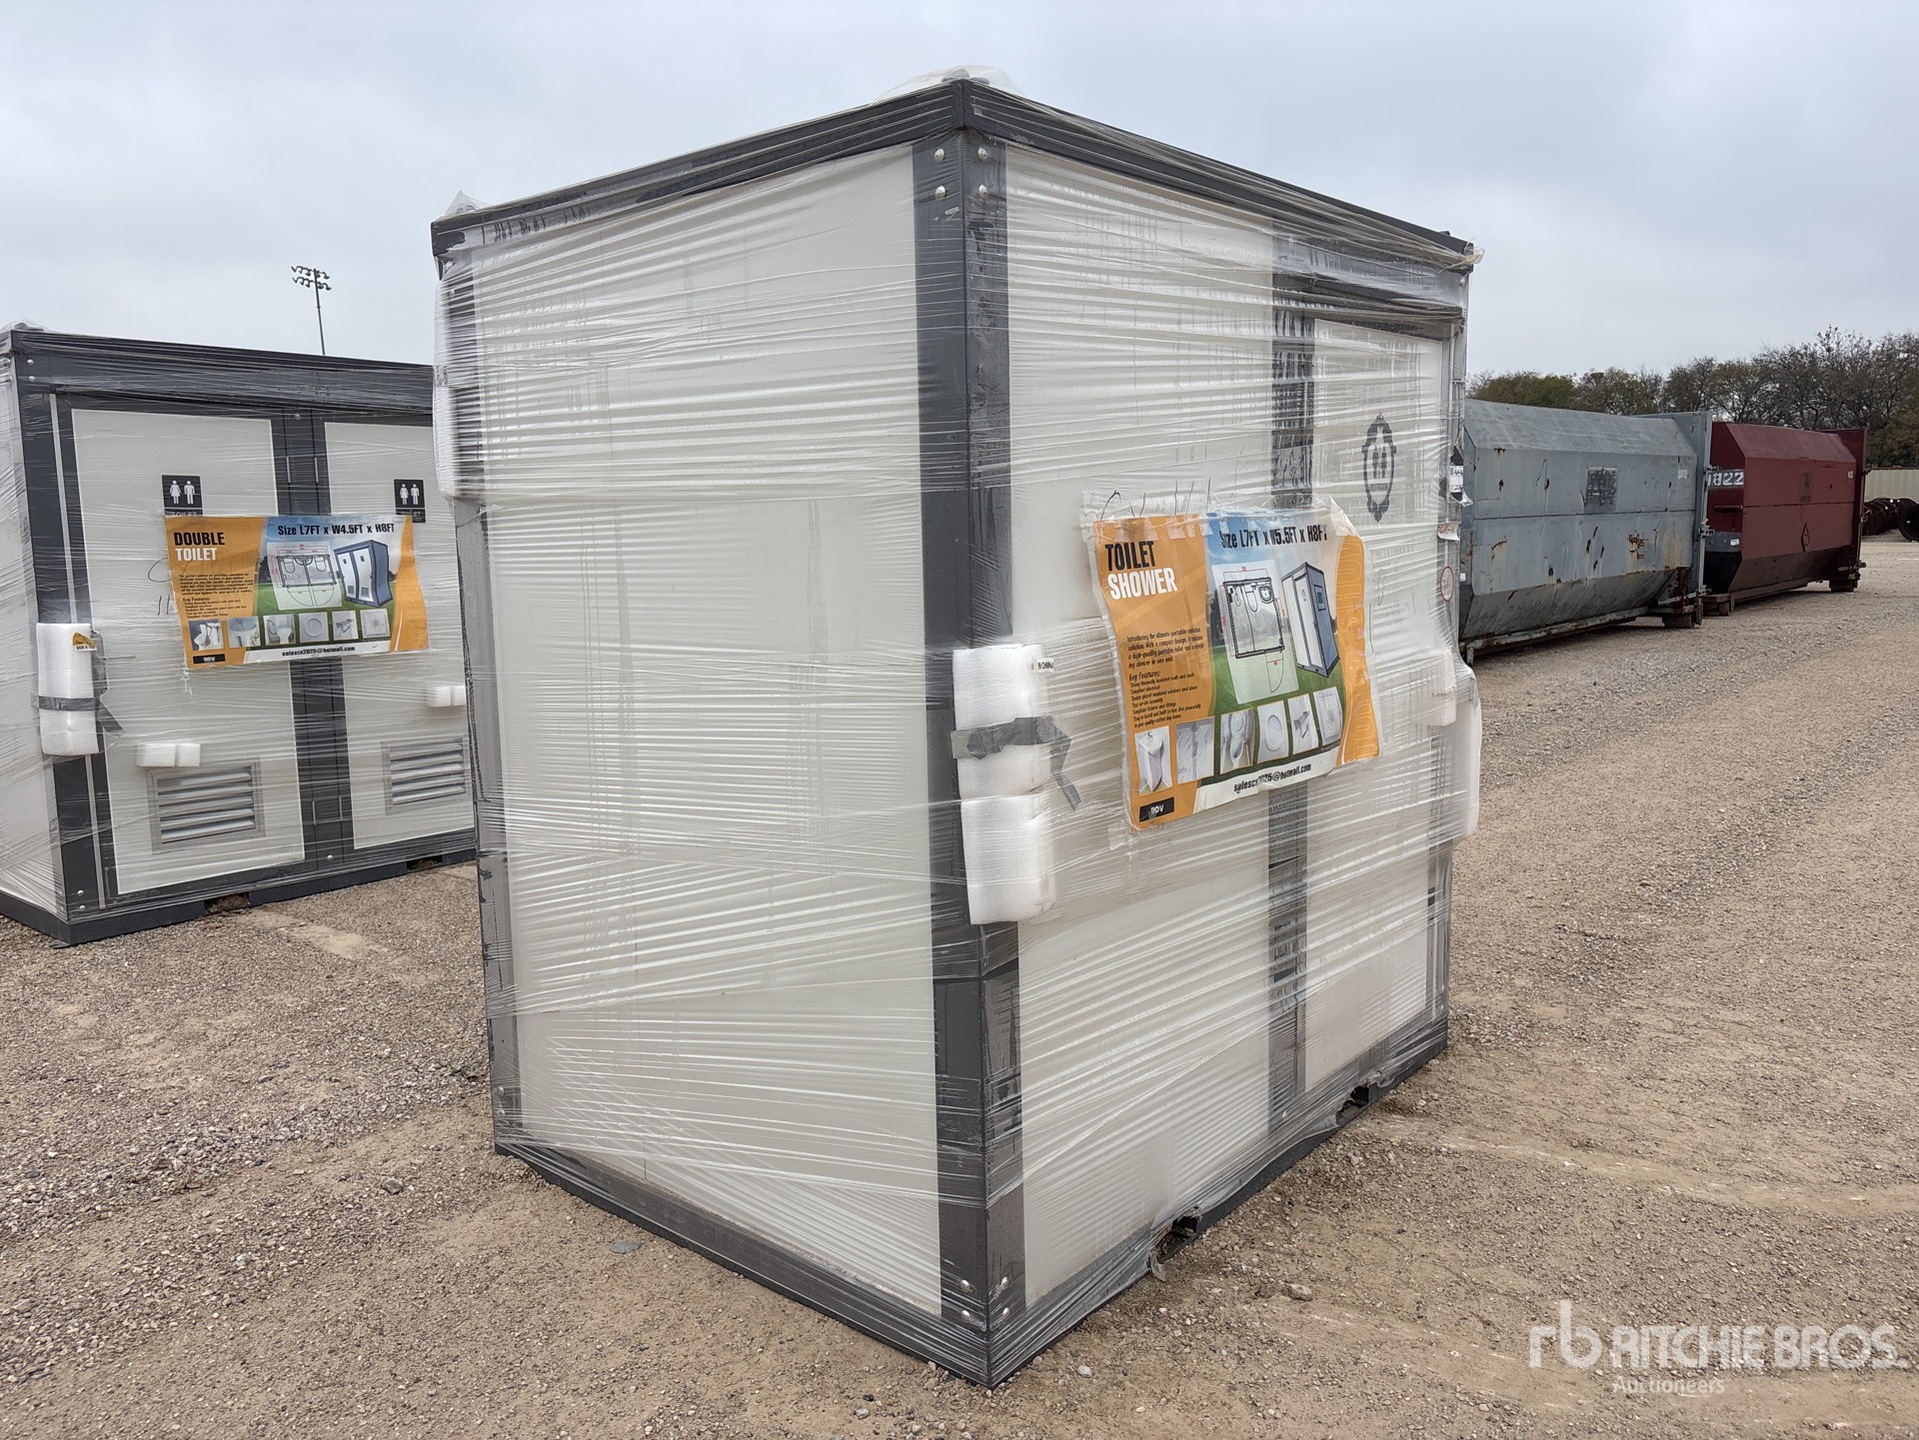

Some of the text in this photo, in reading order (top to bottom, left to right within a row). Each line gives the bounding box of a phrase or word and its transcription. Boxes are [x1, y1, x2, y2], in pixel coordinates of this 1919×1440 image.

[278, 523, 394, 535] Size L7FT x W4.5FT x H8FT
[174, 532, 225, 545] DOUBLE
[1219, 531, 1238, 548] Size
[1239, 529, 1260, 547] L7FT
[1263, 531, 1270, 545] x
[1299, 529, 1306, 543] x
[175, 548, 217, 561] TOILET
[1105, 541, 1155, 571] TOILET
[1108, 567, 1178, 600] SHOWER
